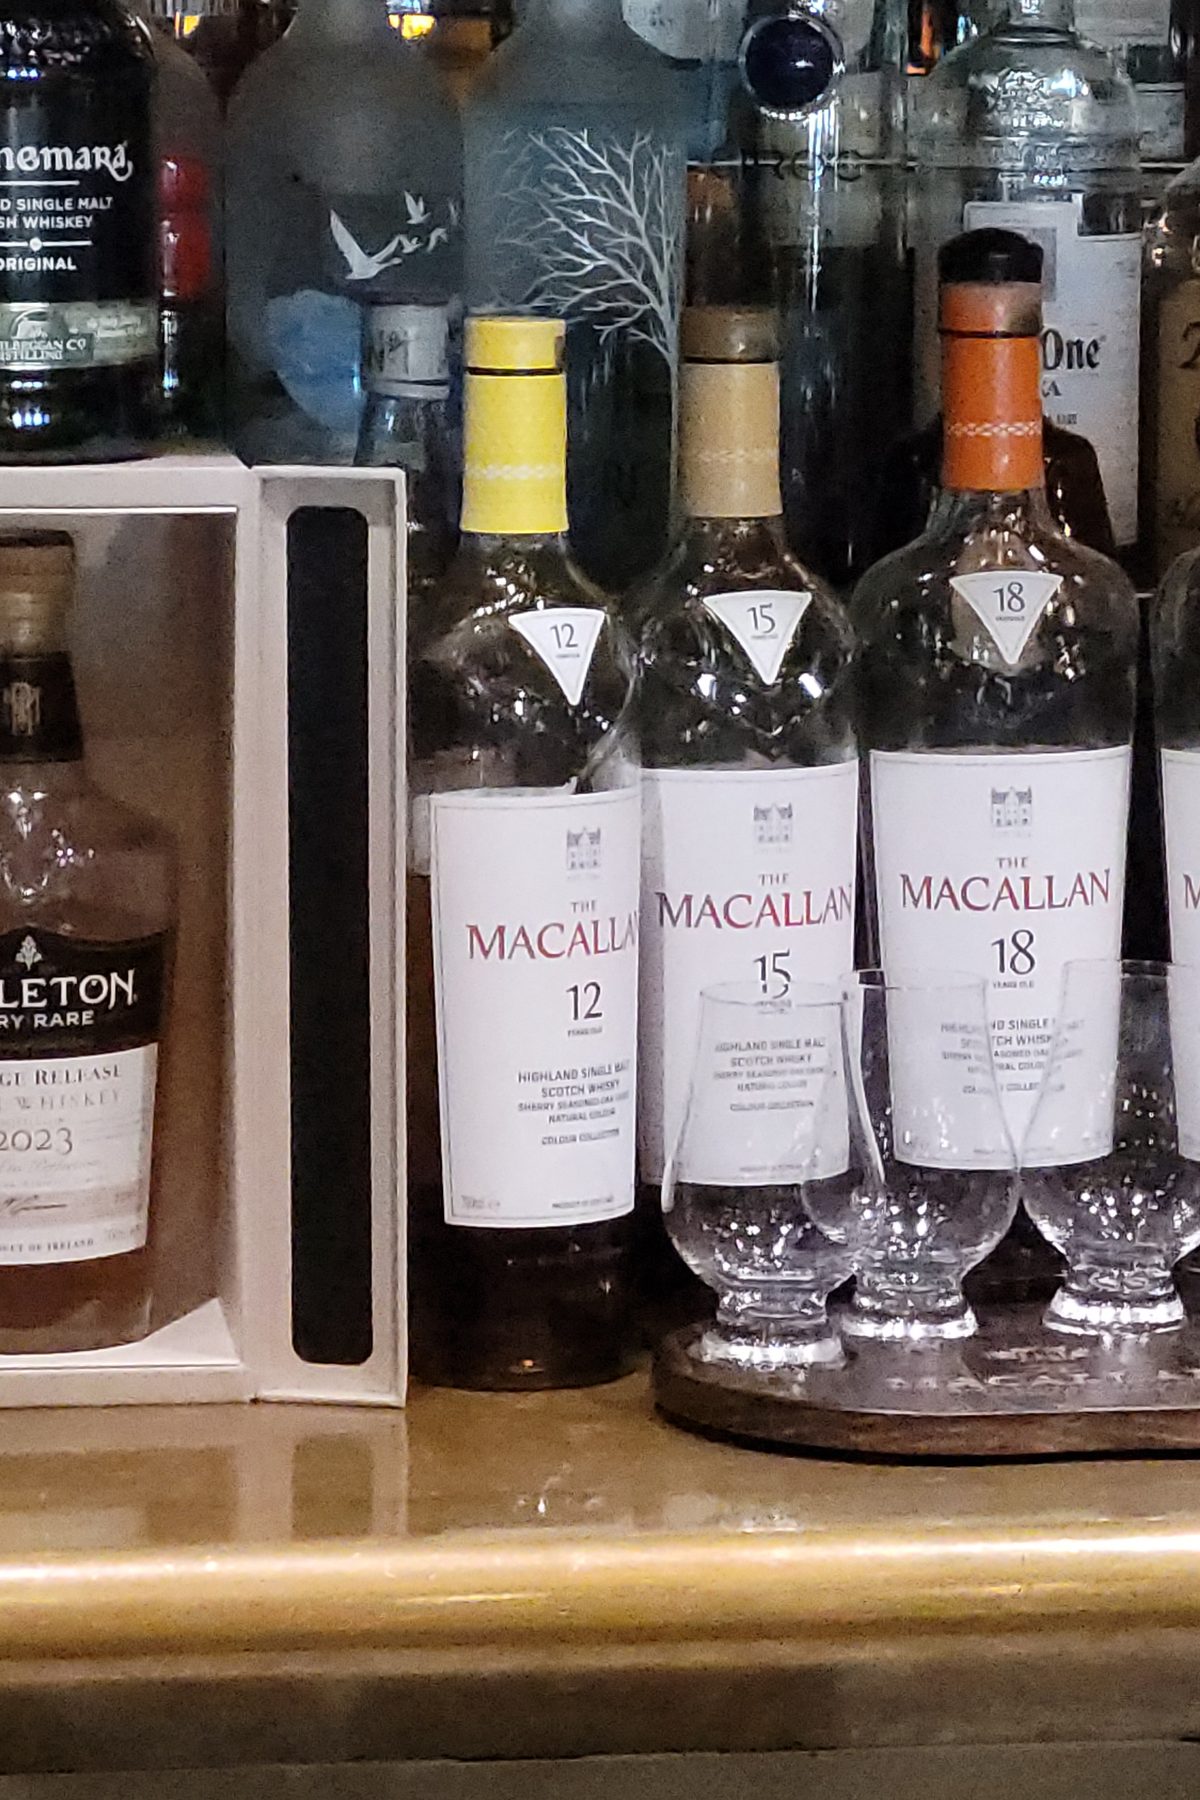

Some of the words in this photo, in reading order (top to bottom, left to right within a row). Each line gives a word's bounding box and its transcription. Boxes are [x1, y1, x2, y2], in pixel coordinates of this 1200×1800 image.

[16, 198, 75, 211] SINGLE
[78, 196, 113, 210] MALT
[22, 215, 93, 229] WHISKEY
[0, 256, 77, 271] ORIGINAL
[1042, 328, 1101, 371] One
[993, 581, 1026, 613] 18
[746, 602, 776, 634] 15
[549, 622, 578, 649] 12
[997, 857, 1029, 868] THE
[758, 873, 790, 886] THE
[899, 868, 1110, 912] MACALLAN
[570, 900, 598, 914] THE
[655, 882, 852, 929] MACALLAN
[991, 929, 1036, 976] 18
[753, 948, 791, 999] 15
[566, 981, 603, 1021] 12
[33, 1010, 95, 1028] RARE
[35, 1064, 122, 1086] RELEASE
[518, 1069, 578, 1084] HIGHLAND
[541, 1084, 585, 1099] SCOTCH
[0, 1126, 73, 1156] 2023
